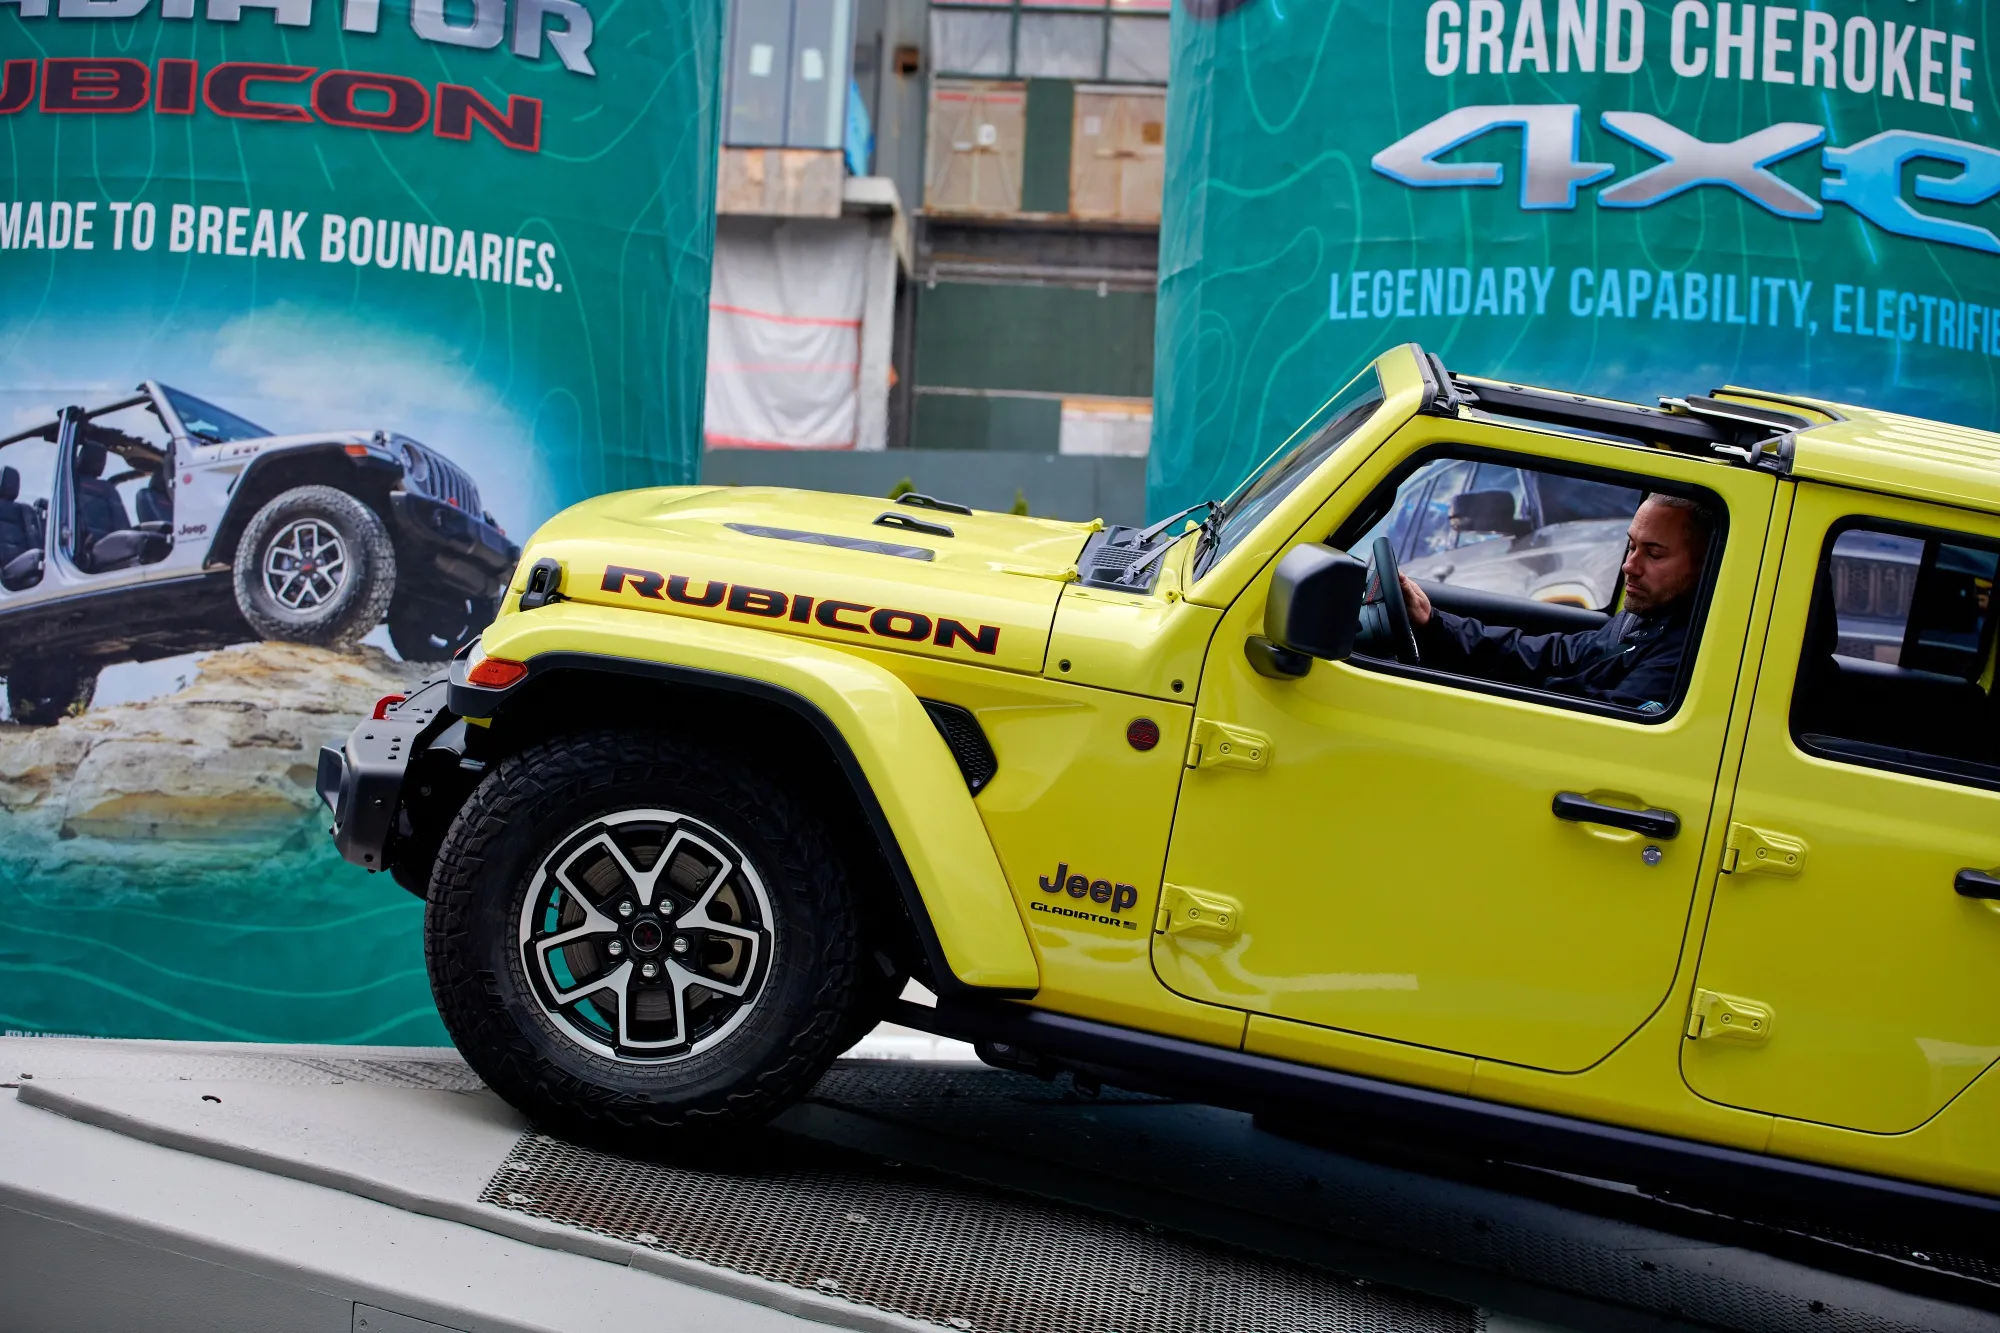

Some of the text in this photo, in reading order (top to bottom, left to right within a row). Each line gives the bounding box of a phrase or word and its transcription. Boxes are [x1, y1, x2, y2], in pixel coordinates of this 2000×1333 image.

[1425, 0, 1975, 112] GRAND CHEROKEE
[109, 201, 156, 251] TO
[169, 203, 309, 260] BREAK
[320, 213, 562, 293] BOUNDARIES.
[1329, 266, 1555, 321] LEGENDARY
[1569, 267, 1818, 336] CAPABILITY,
[600, 564, 1001, 655] RUBICON
[1030, 901, 1121, 927] GLADIATOR
[1039, 861, 1137, 914] Jeep
